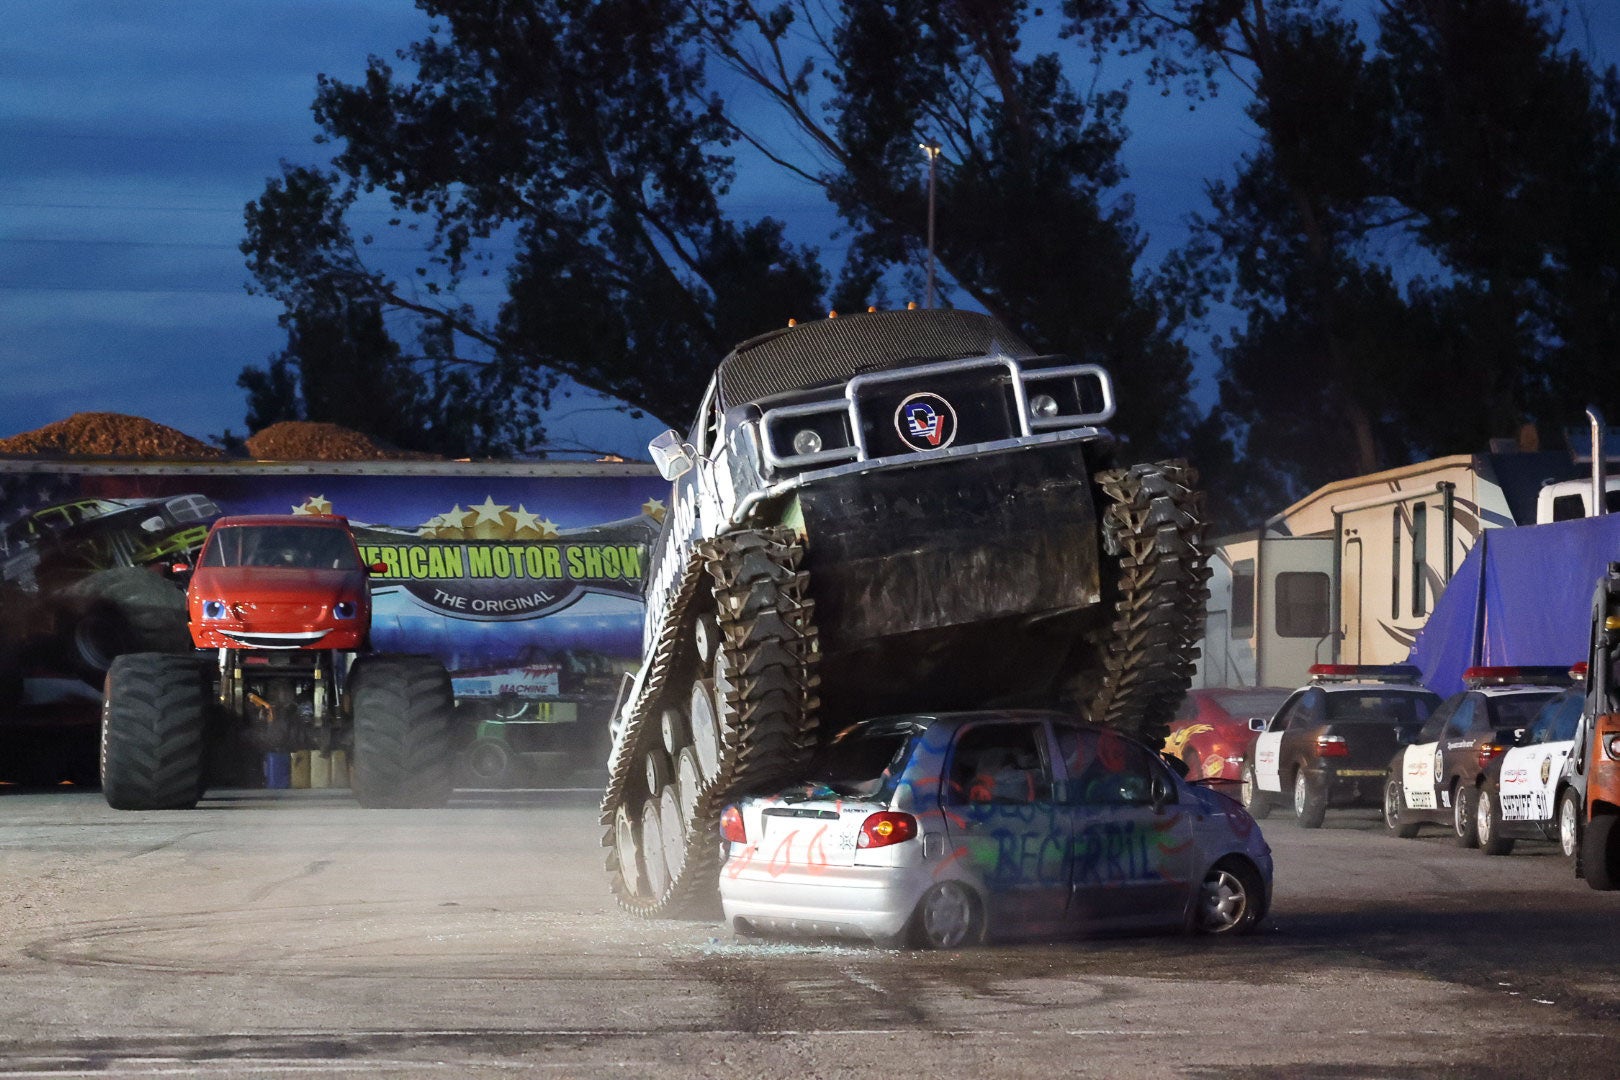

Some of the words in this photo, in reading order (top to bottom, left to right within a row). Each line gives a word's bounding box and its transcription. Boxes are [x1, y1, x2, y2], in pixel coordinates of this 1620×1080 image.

[467, 545, 564, 579] MOTOR
[567, 545, 642, 579] SHOW
[434, 588, 467, 610] THE
[471, 589, 555, 613] ORIGINAL
[500, 684, 549, 694] MACHINE
